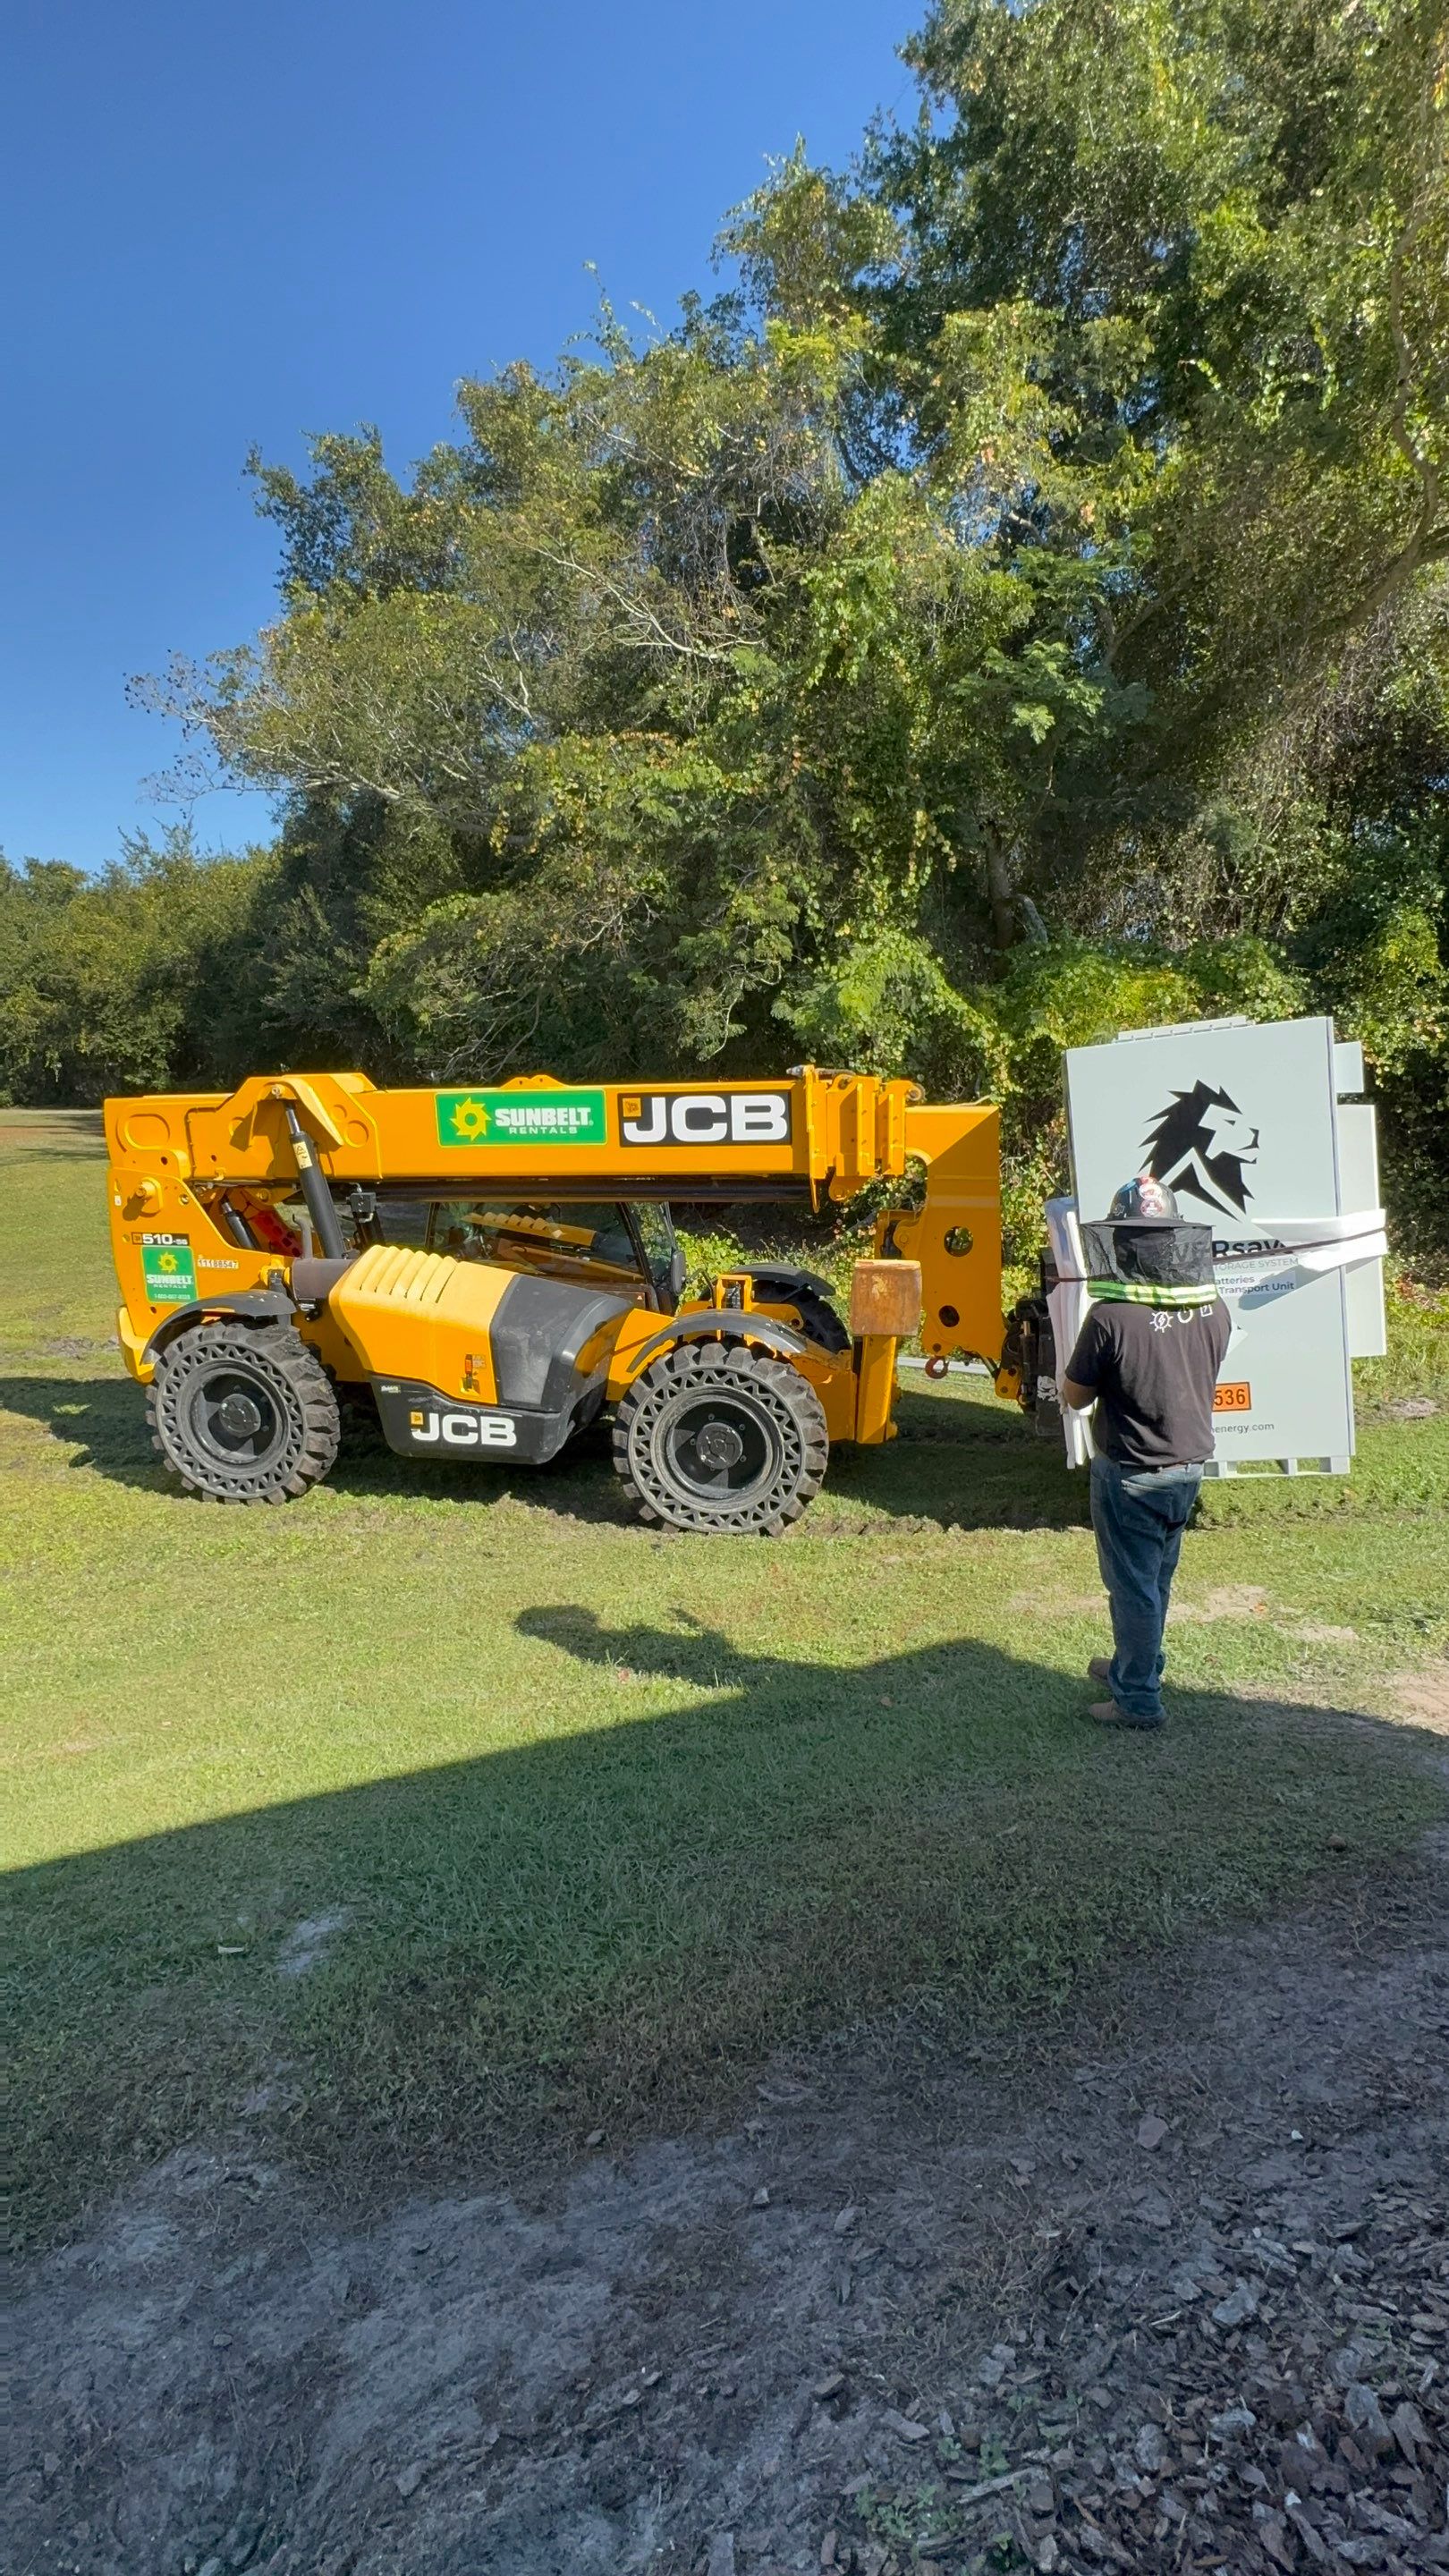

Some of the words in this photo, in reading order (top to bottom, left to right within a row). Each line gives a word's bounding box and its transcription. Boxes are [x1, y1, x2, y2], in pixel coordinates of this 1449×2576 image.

[495, 1107, 591, 1126] SUNBELT
[623, 1095, 788, 1142] JCB
[1213, 1261, 1257, 1272] TORAGE
[1258, 1258, 1299, 1268] SYSTEM
[147, 1275, 192, 1284] SUNBELT
[1215, 1275, 1255, 1285] atteries
[1219, 1284, 1269, 1294] Transport
[1273, 1282, 1294, 1291] Unit
[1215, 1388, 1246, 1406] 536
[411, 1412, 517, 1446] JCB
